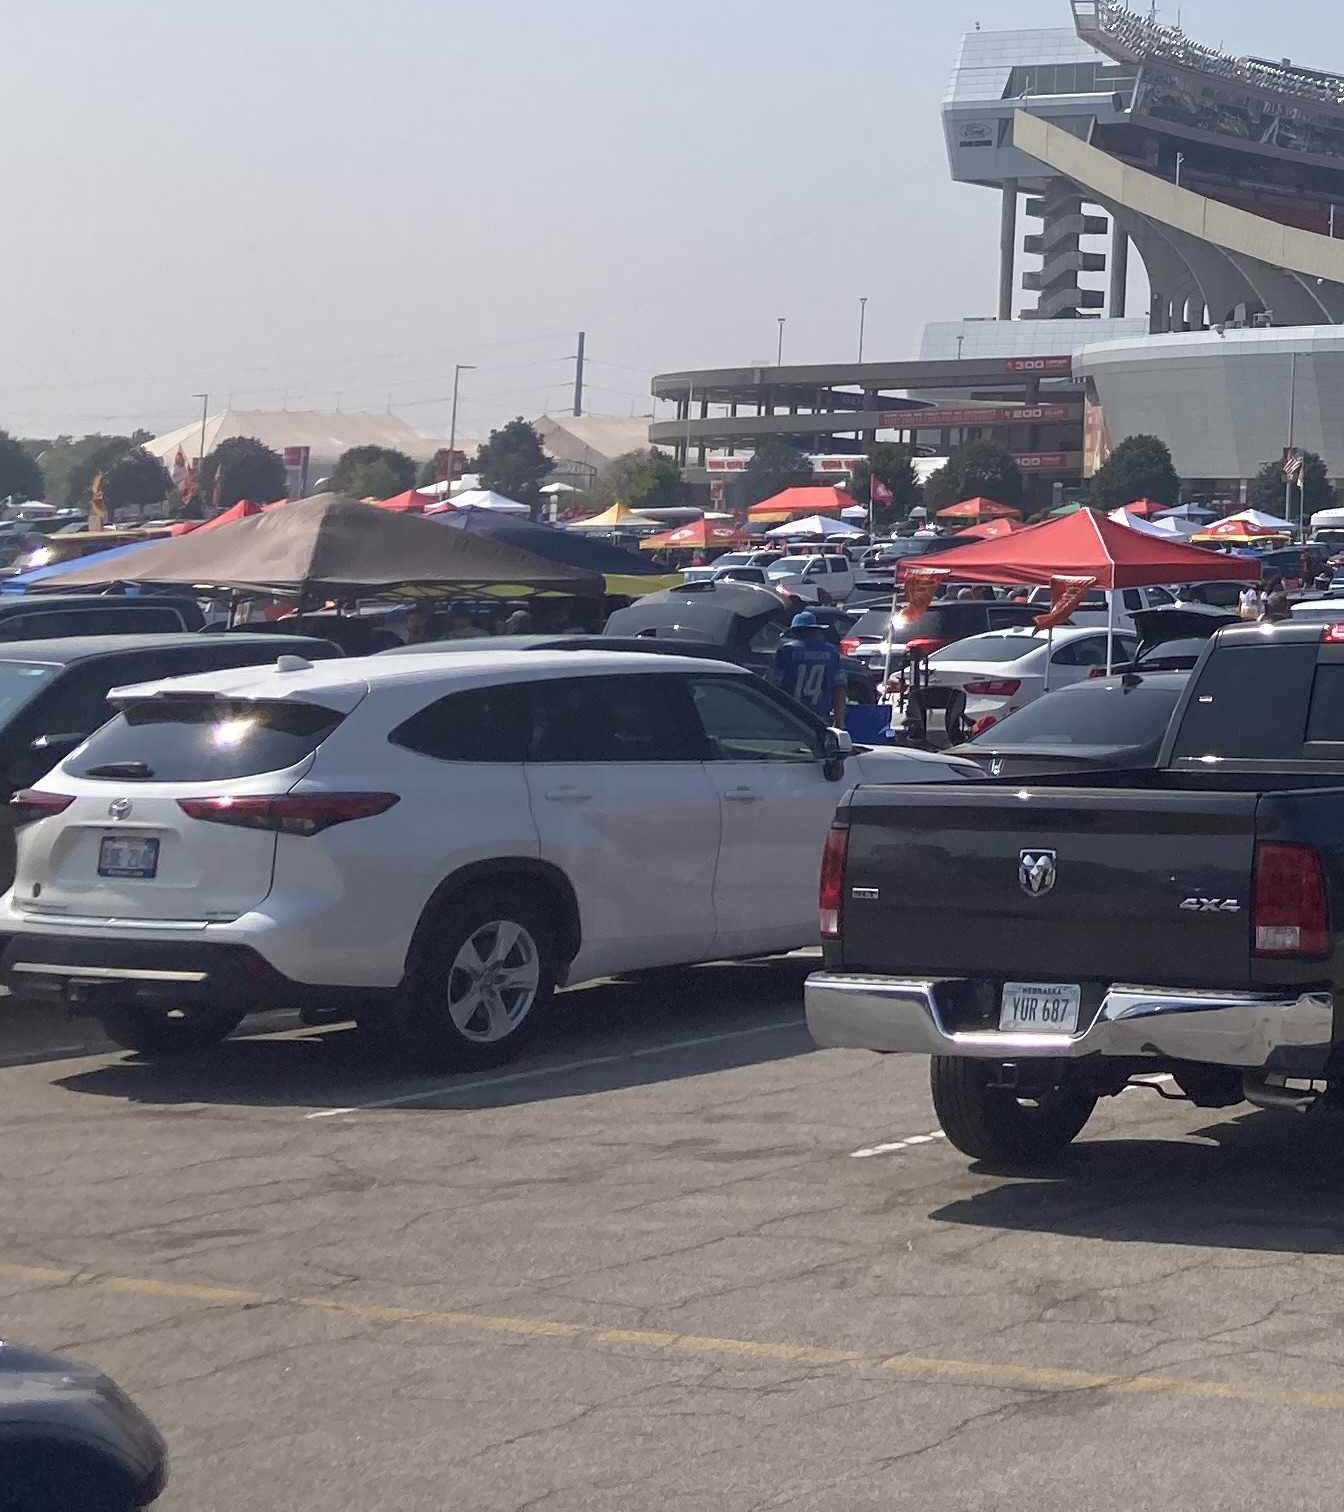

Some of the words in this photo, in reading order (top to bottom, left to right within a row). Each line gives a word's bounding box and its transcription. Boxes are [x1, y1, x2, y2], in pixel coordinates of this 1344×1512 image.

[1015, 360, 1044, 370] 300
[1013, 409, 1042, 418] 200
[794, 663, 826, 705] 14
[1013, 997, 1038, 1021] YUR
[1042, 998, 1069, 1023] 687
